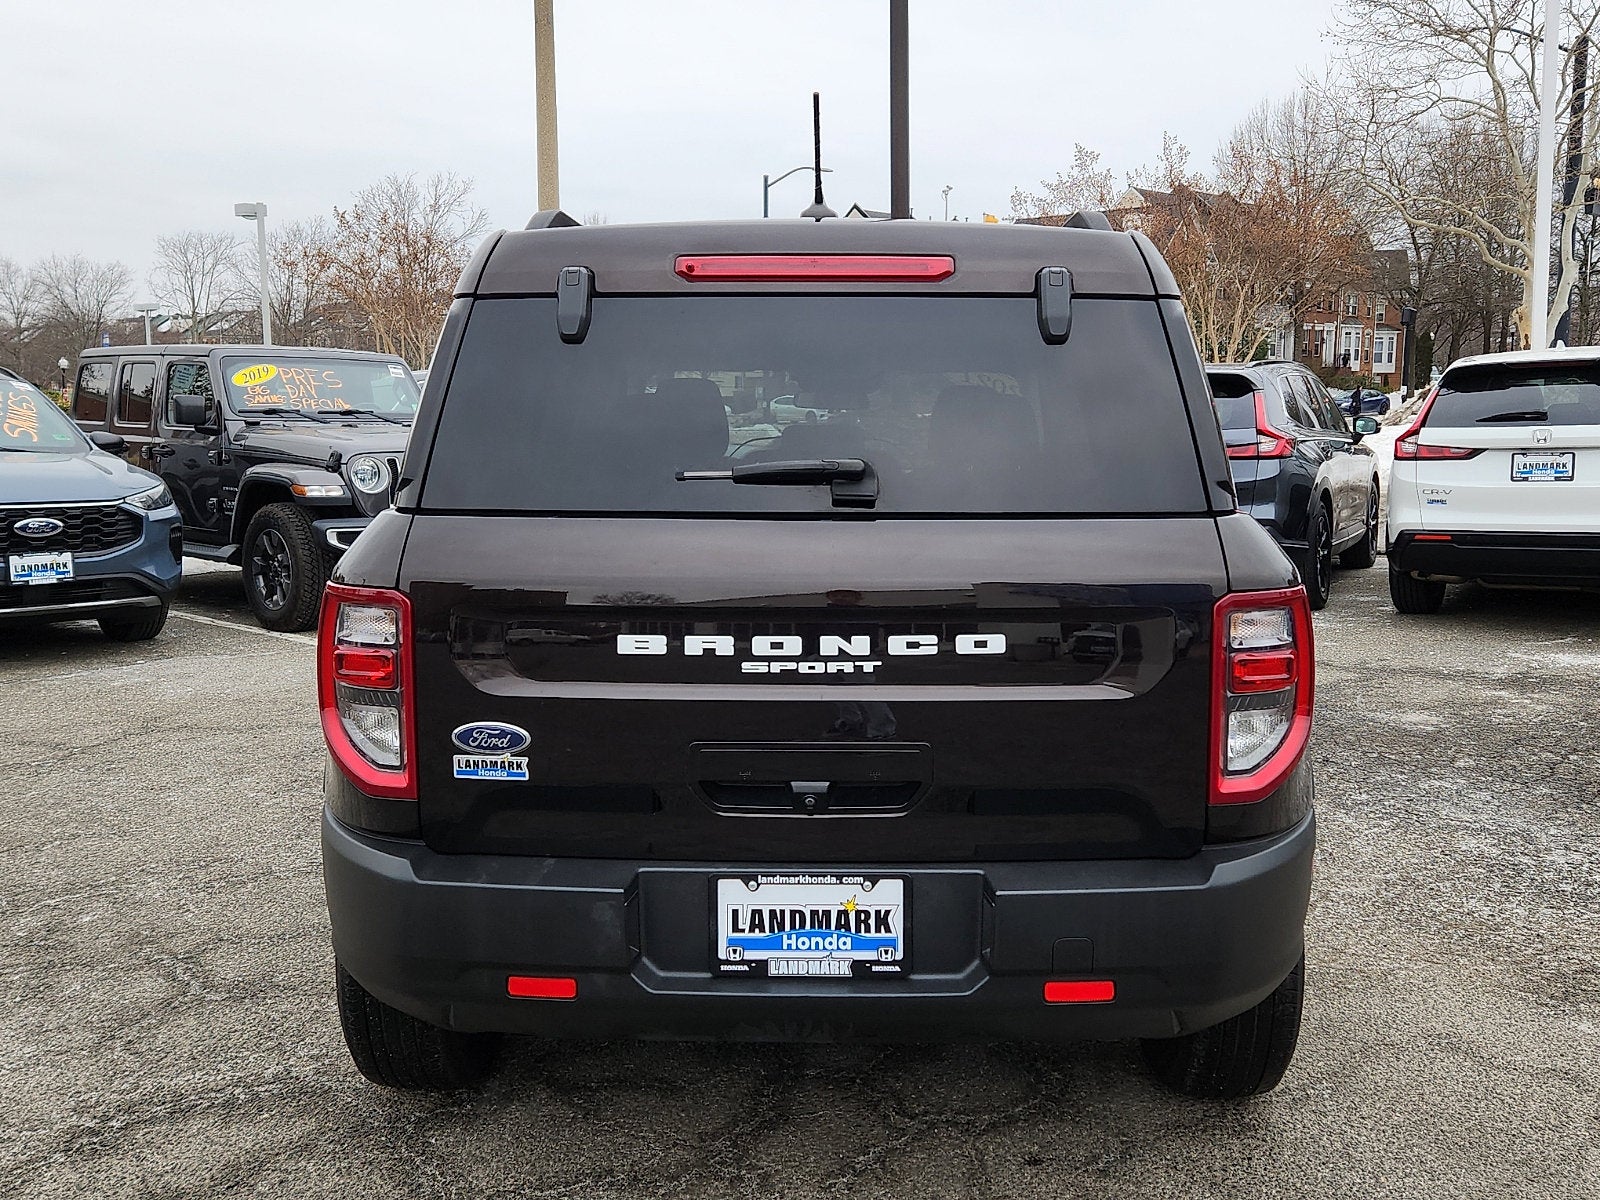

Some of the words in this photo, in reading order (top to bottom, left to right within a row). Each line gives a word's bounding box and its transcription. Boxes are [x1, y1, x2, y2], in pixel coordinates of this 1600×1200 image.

[242, 366, 269, 384] 2019
[278, 367, 342, 388] PRES
[286, 384, 318, 398] DAY
[289, 397, 351, 409] SPECIAL
[1517, 462, 1568, 470] LANDMARK
[14, 562, 69, 573] LANDMARK
[616, 634, 1007, 656] BRONCO
[741, 661, 883, 673] SPORT
[468, 728, 512, 747] Ford
[457, 759, 524, 771] LANDMARK
[477, 769, 508, 777] Honda
[731, 908, 893, 934] LANDMARK
[782, 934, 852, 950] Honda
[770, 959, 851, 975] LANDMARK
